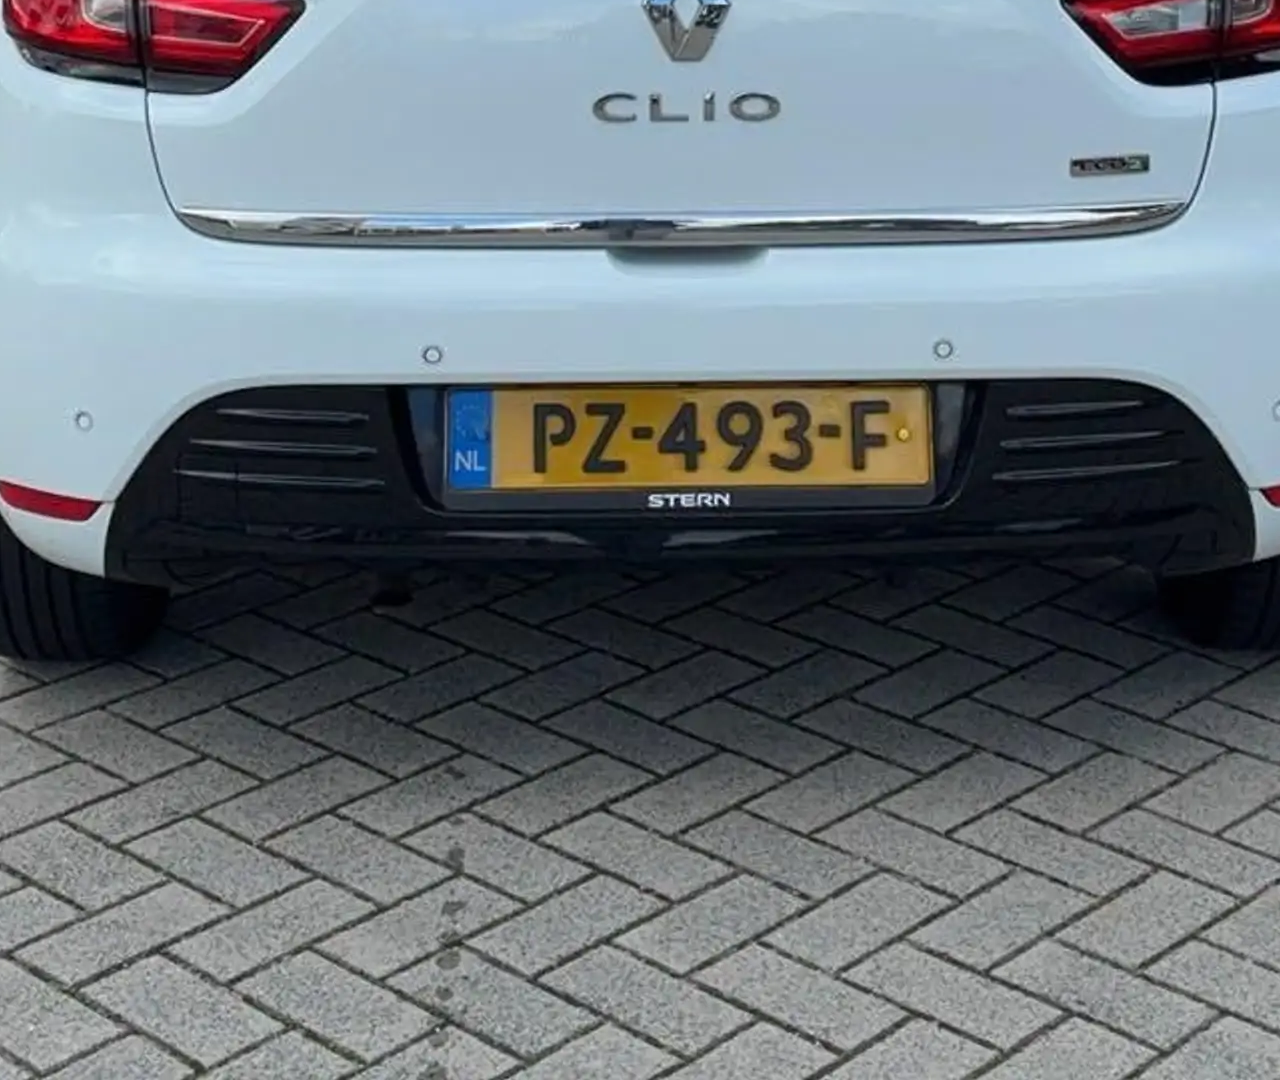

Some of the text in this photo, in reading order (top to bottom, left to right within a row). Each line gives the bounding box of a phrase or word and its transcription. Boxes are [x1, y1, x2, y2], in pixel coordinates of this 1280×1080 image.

[592, 91, 781, 123] CLIO
[532, 400, 890, 474] PZ-493-F
[454, 450, 487, 473] NL
[647, 491, 731, 508] STERN
